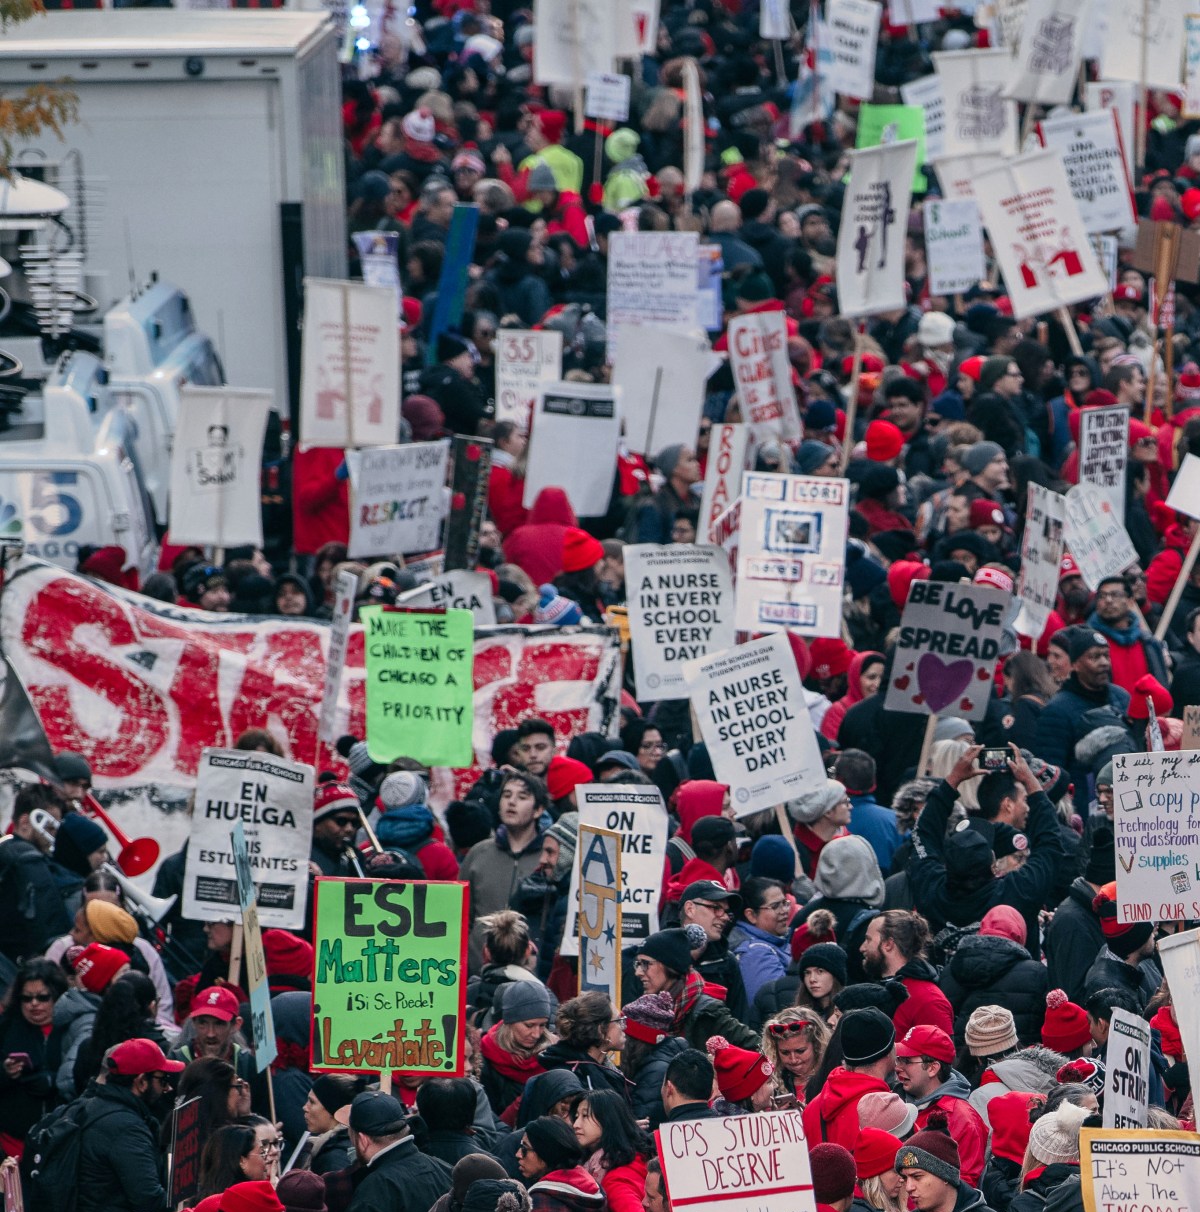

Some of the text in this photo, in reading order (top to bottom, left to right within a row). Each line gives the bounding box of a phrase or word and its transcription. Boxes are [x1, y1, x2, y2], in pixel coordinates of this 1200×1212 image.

[32, 471, 82, 535] 5
[361, 497, 430, 526] RESPECT
[658, 573, 720, 590] NURSE
[640, 591, 723, 608] IN EVERY
[909, 583, 1004, 630] BE LOVE
[643, 609, 722, 626] SCHOOL
[370, 619, 448, 639] MAKE THE
[656, 628, 713, 645] EVERY
[370, 644, 441, 662] CHILDREN
[663, 644, 707, 661] DAY!
[899, 627, 999, 660] SPREAD
[378, 670, 438, 687] CHICAGO
[724, 669, 784, 699] NURSE
[736, 687, 790, 717] EVERY
[382, 702, 465, 724] PRIORITY
[718, 706, 795, 742] SCHOOL
[732, 726, 788, 758] EVERY
[746, 750, 787, 773] DAY!
[1134, 757, 1155, 767] use
[241, 782, 268, 802] EN
[1149, 792, 1184, 813] copy
[206, 801, 296, 828] HUELGA
[606, 811, 635, 831] ON
[1118, 816, 1179, 836] technology
[1140, 830, 1199, 846] classroom
[199, 849, 298, 872] ESTUANTES
[1138, 852, 1188, 867] supplies
[344, 883, 446, 938] ESL
[1122, 903, 1152, 921] FUND
[1159, 903, 1186, 920] OUR
[317, 939, 457, 985] Matters
[396, 992, 434, 1009] Puede!
[1124, 1046, 1142, 1075] ON
[1112, 1073, 1148, 1107] STRIKE
[670, 1112, 807, 1158] CPS STUDENTS
[1091, 1142, 1200, 1156] CHICAGO PUBLIC SCHOOLS
[702, 1148, 784, 1190] DESERVE
[1101, 1185, 1139, 1202] About
